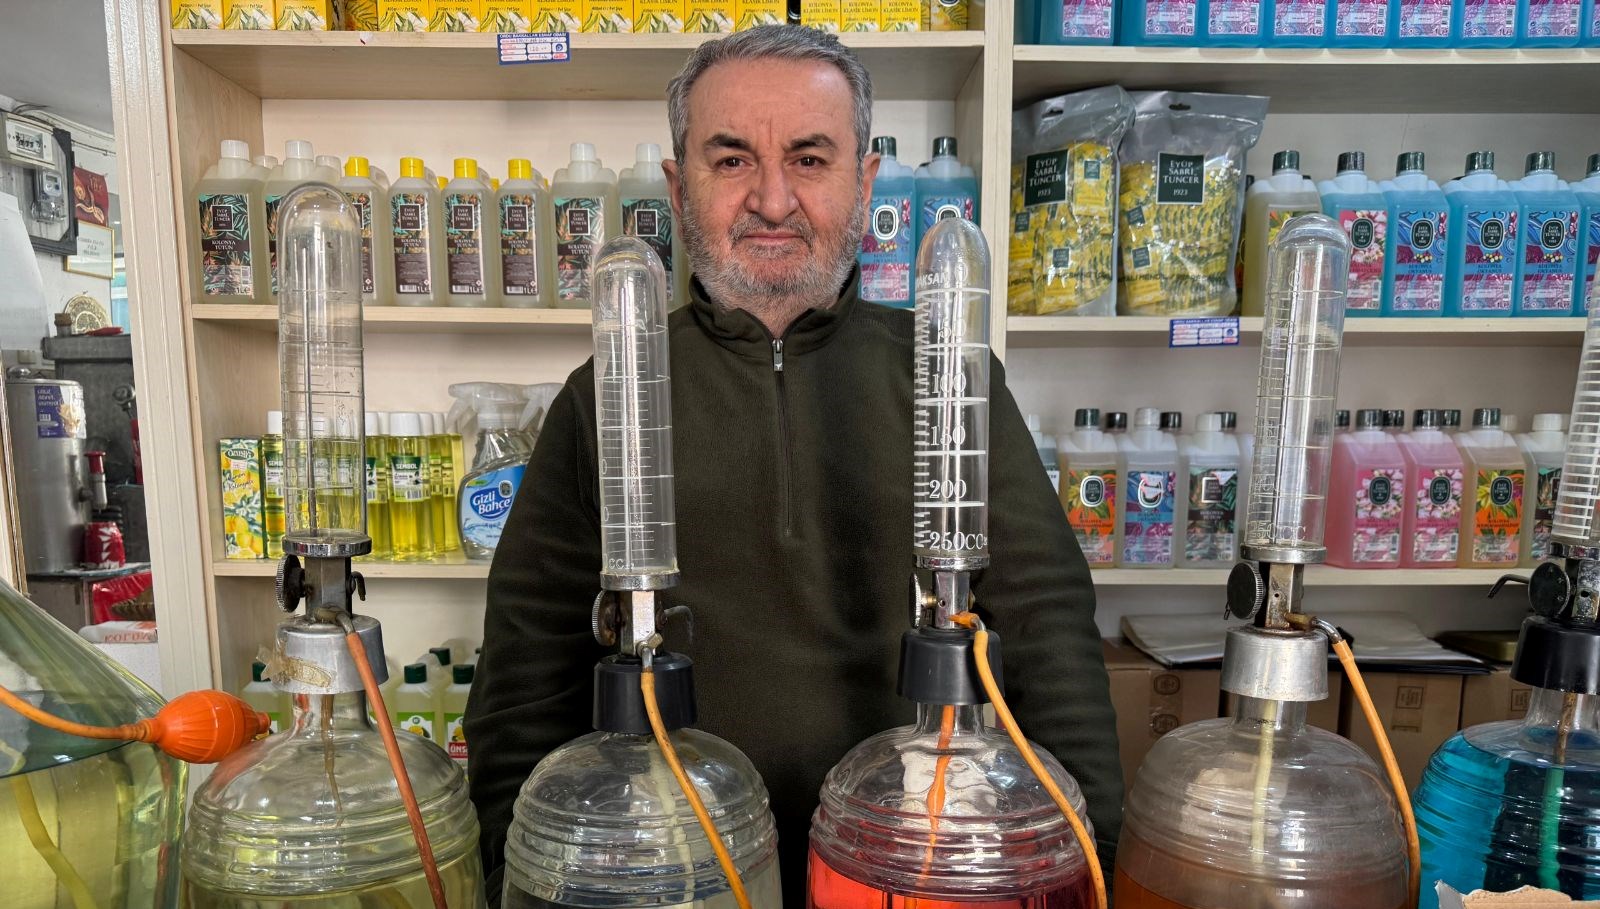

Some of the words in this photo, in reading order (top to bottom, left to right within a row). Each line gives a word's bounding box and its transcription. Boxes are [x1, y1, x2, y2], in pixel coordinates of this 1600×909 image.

[1036, 158, 1057, 169] EYÜP
[1029, 174, 1061, 186] TUNCER
[1163, 175, 1199, 184] TUNCER
[932, 373, 966, 393] 100
[930, 425, 966, 446] 150
[929, 480, 967, 498] 200
[473, 491, 495, 506] Gizli
[479, 499, 510, 514] Bahçe
